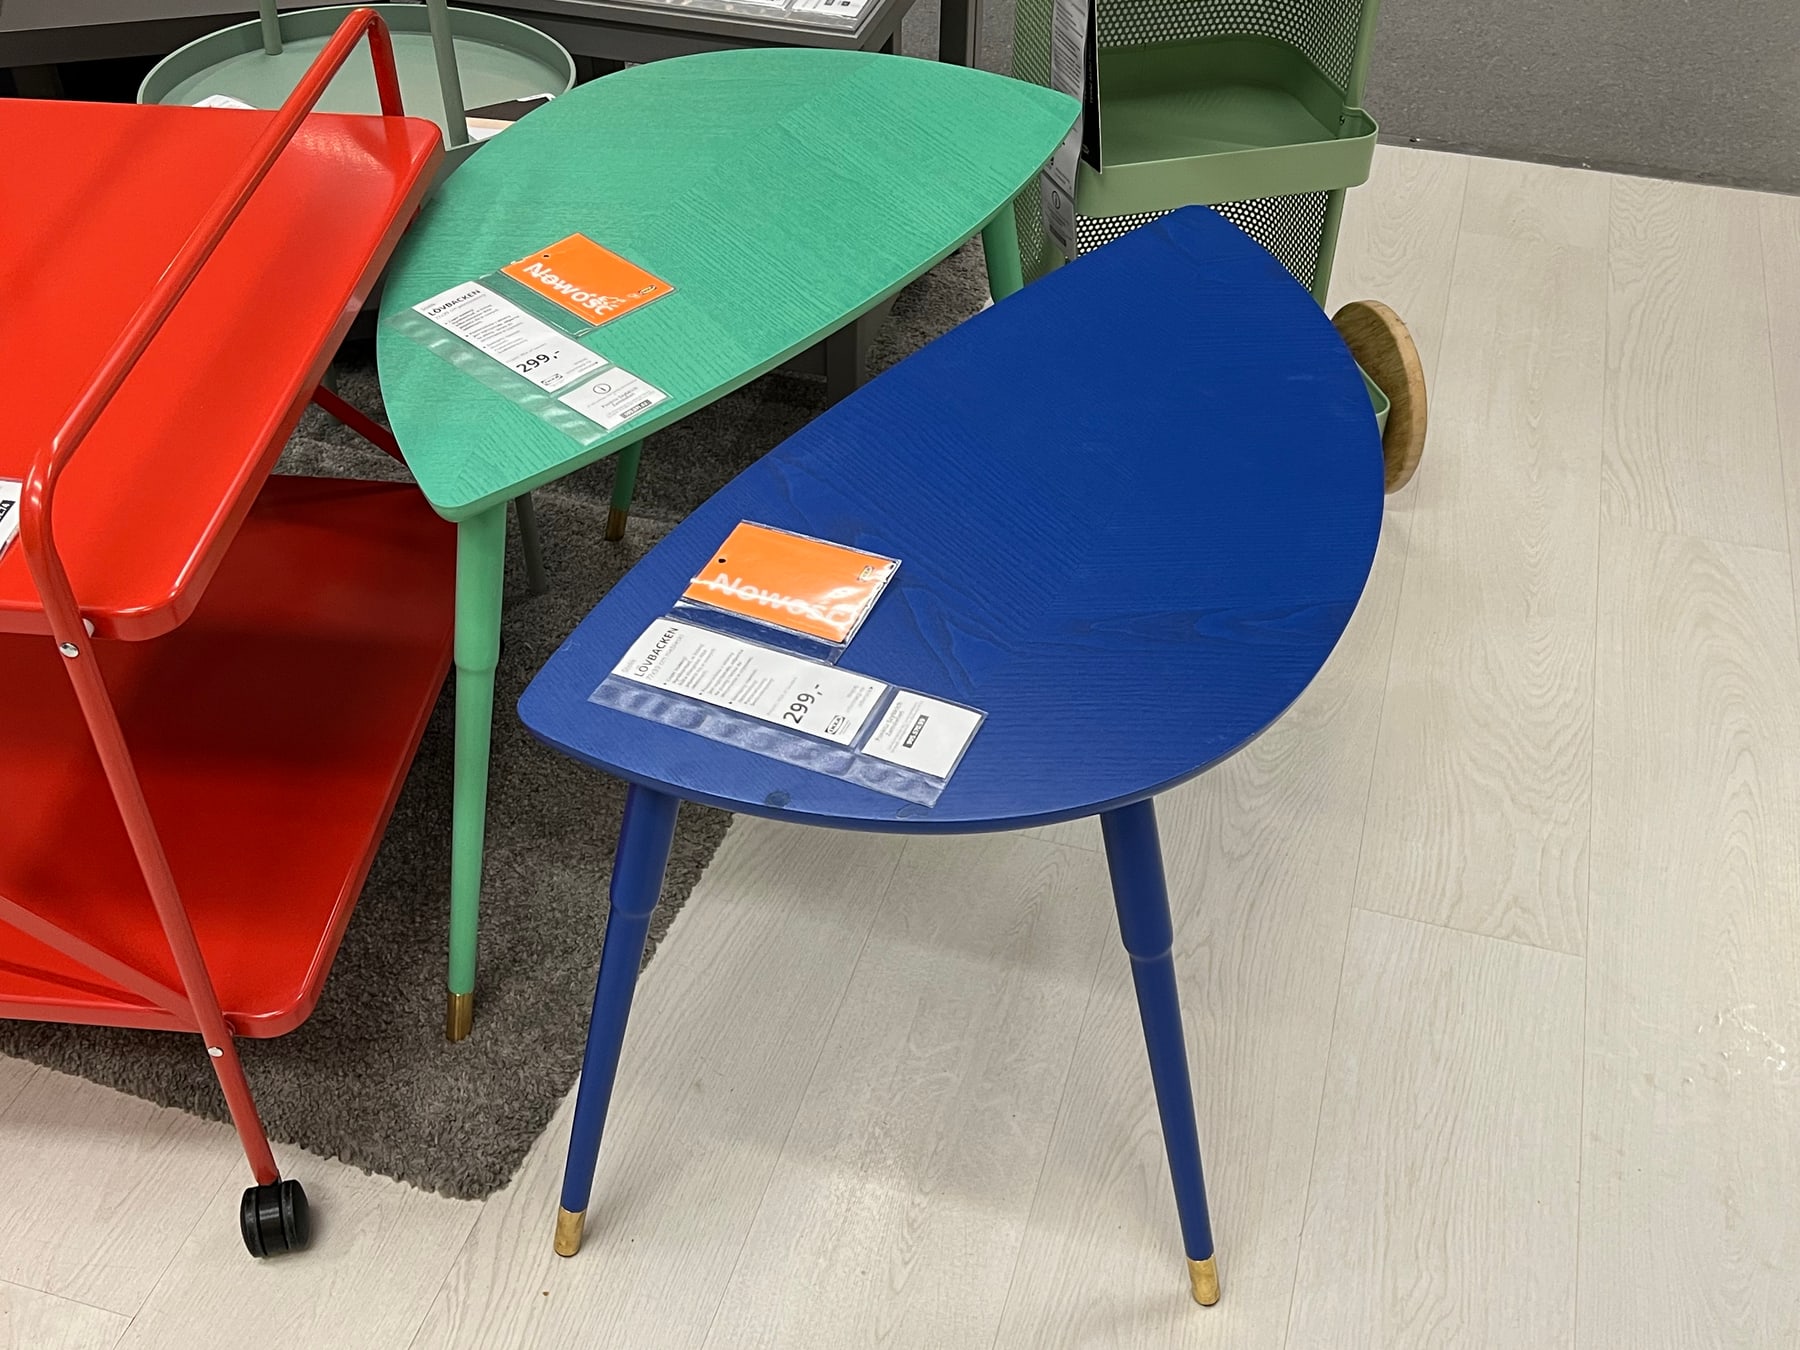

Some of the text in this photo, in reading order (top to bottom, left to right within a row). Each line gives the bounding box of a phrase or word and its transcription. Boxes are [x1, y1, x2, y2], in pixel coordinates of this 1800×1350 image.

[515, 350, 561, 373] 299,-
[634, 627, 679, 677] LÖVBACKEN
[783, 684, 823, 724] 299,-
